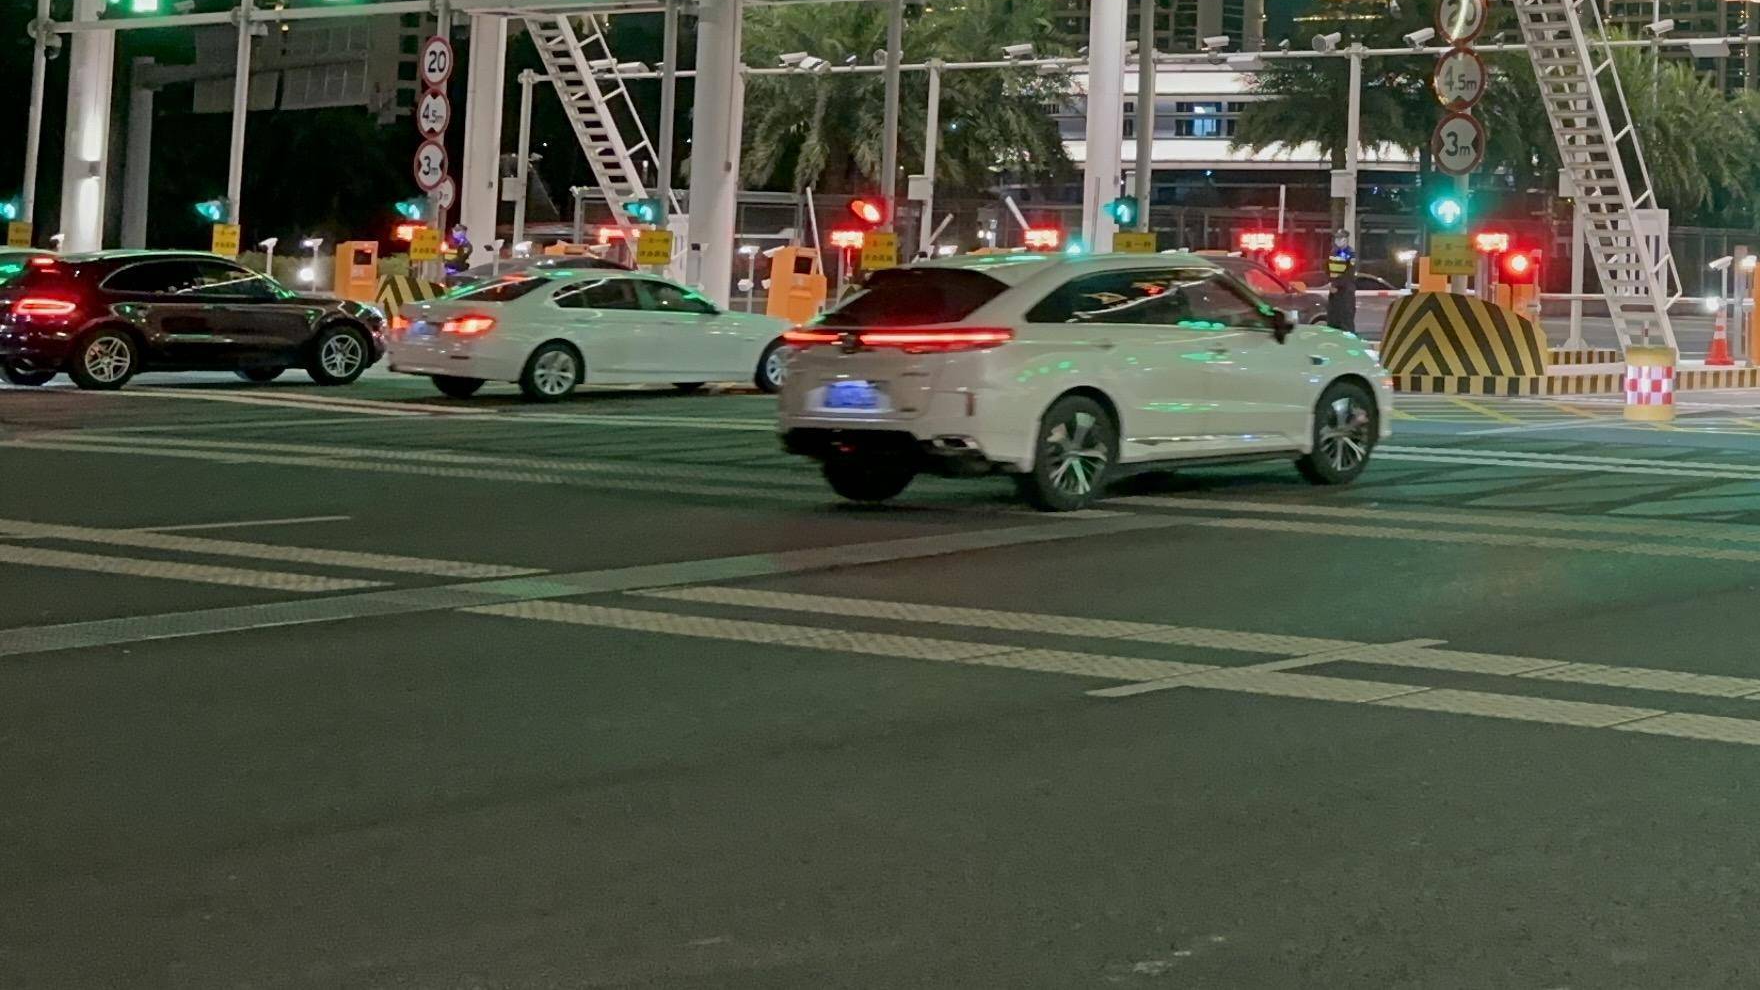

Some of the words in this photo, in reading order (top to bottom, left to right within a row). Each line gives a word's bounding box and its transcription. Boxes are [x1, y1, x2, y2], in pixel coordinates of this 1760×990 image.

[427, 50, 448, 74] 20
[1443, 65, 1478, 92] 4.5m
[1445, 130, 1471, 157] 3m
